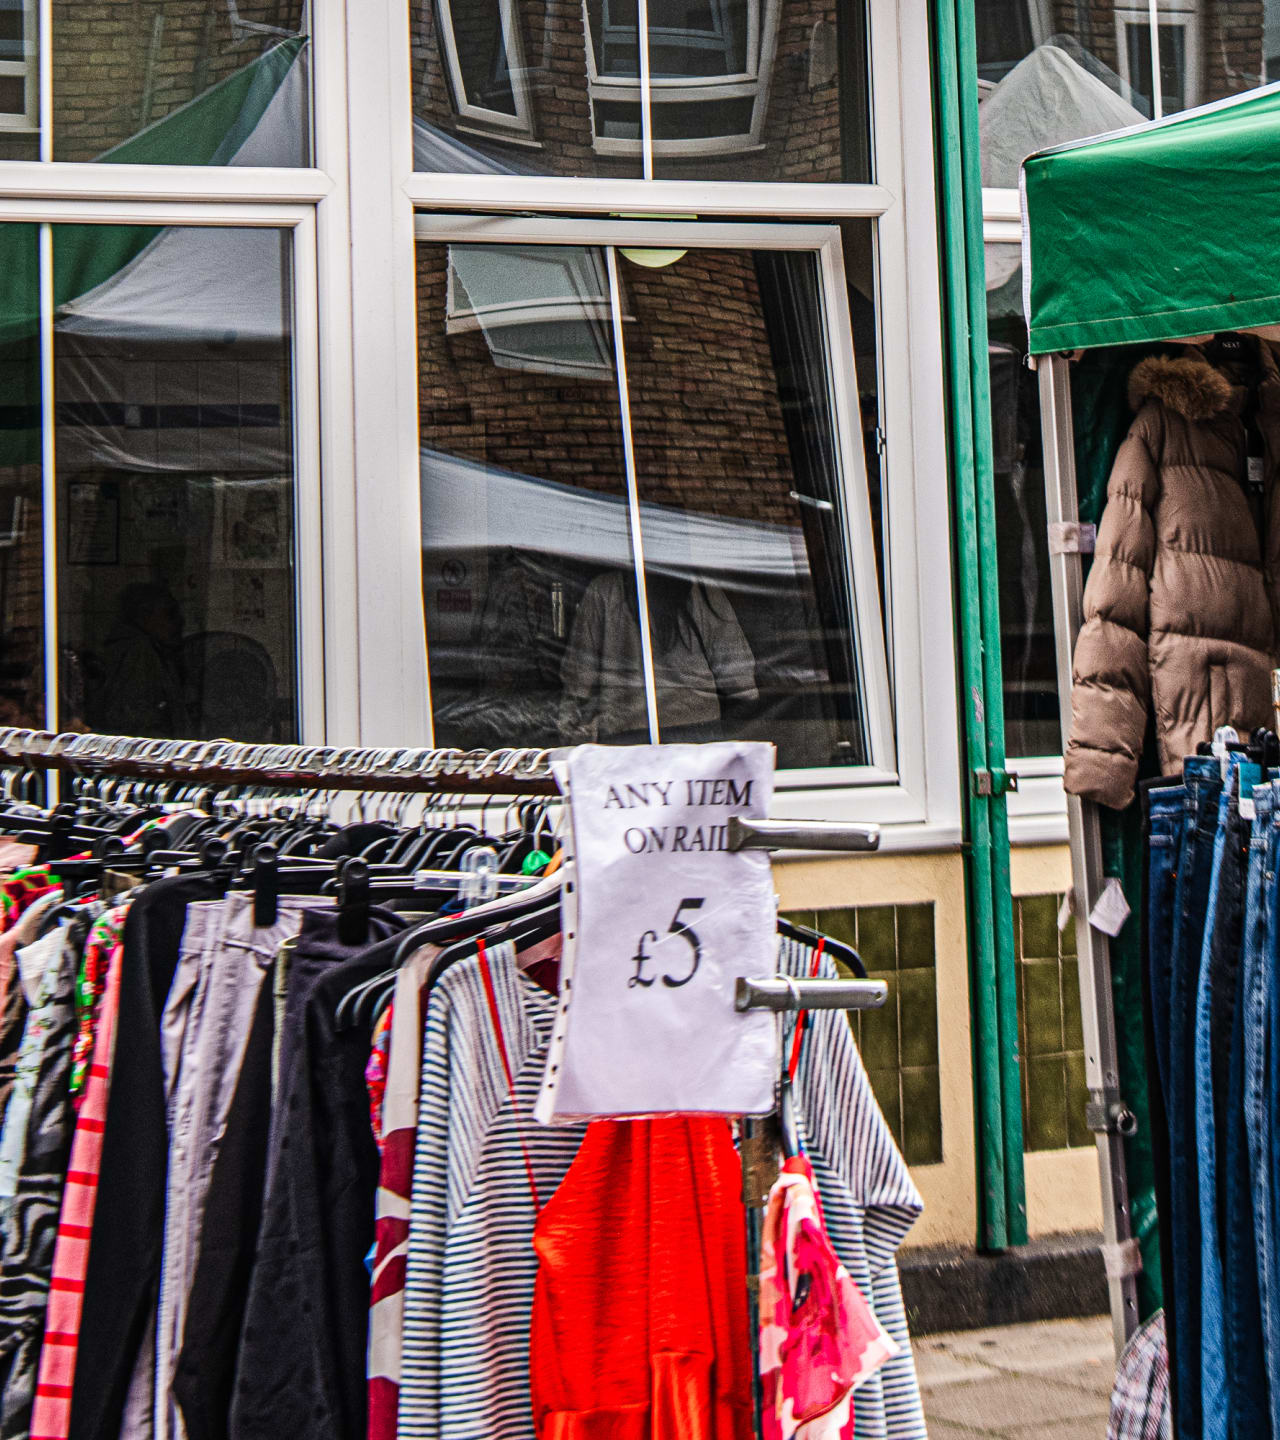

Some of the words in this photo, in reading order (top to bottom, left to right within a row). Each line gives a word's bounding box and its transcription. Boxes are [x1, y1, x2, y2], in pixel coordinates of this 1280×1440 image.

[604, 781, 673, 809] ANY
[686, 779, 754, 807] ITEM
[624, 825, 668, 854] ON
[628, 897, 706, 988] £5
